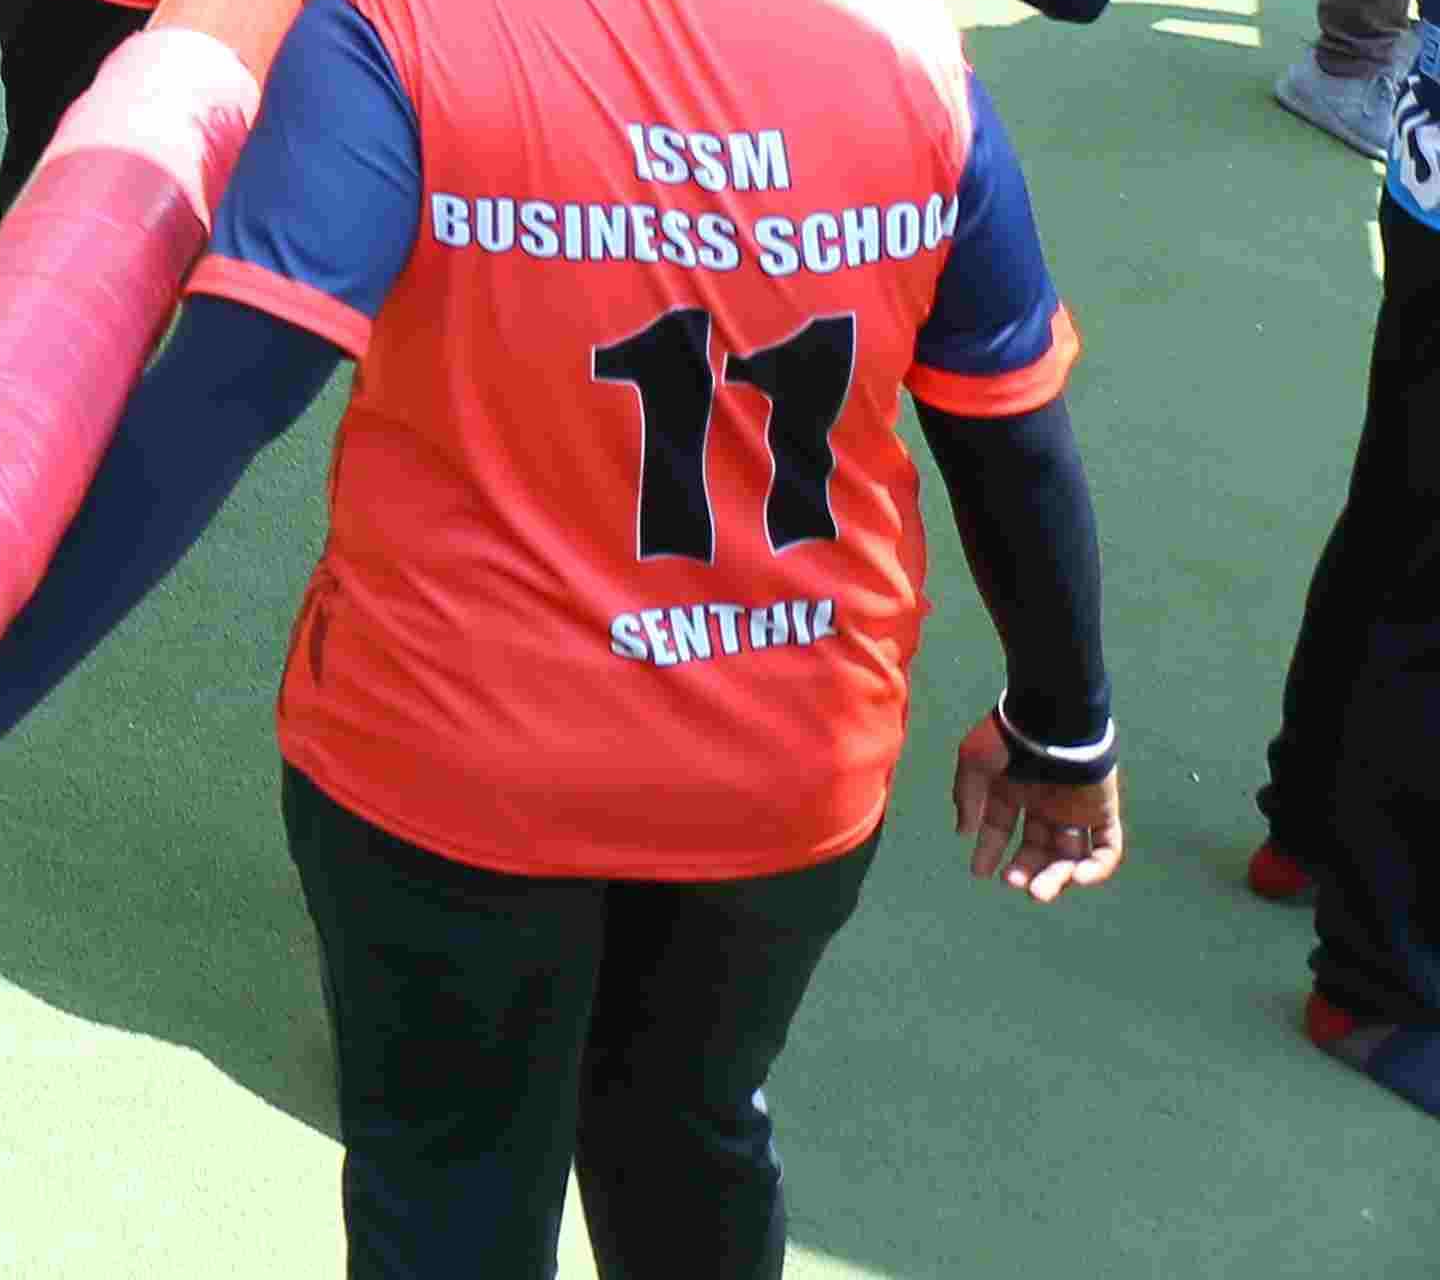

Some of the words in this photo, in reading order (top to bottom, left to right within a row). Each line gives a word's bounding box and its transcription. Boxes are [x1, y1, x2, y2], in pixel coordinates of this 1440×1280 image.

[627, 121, 791, 193] ISSM
[431, 191, 741, 272] BUSINESS
[591, 306, 857, 565] 11
[609, 598, 838, 667] SENTHIL
